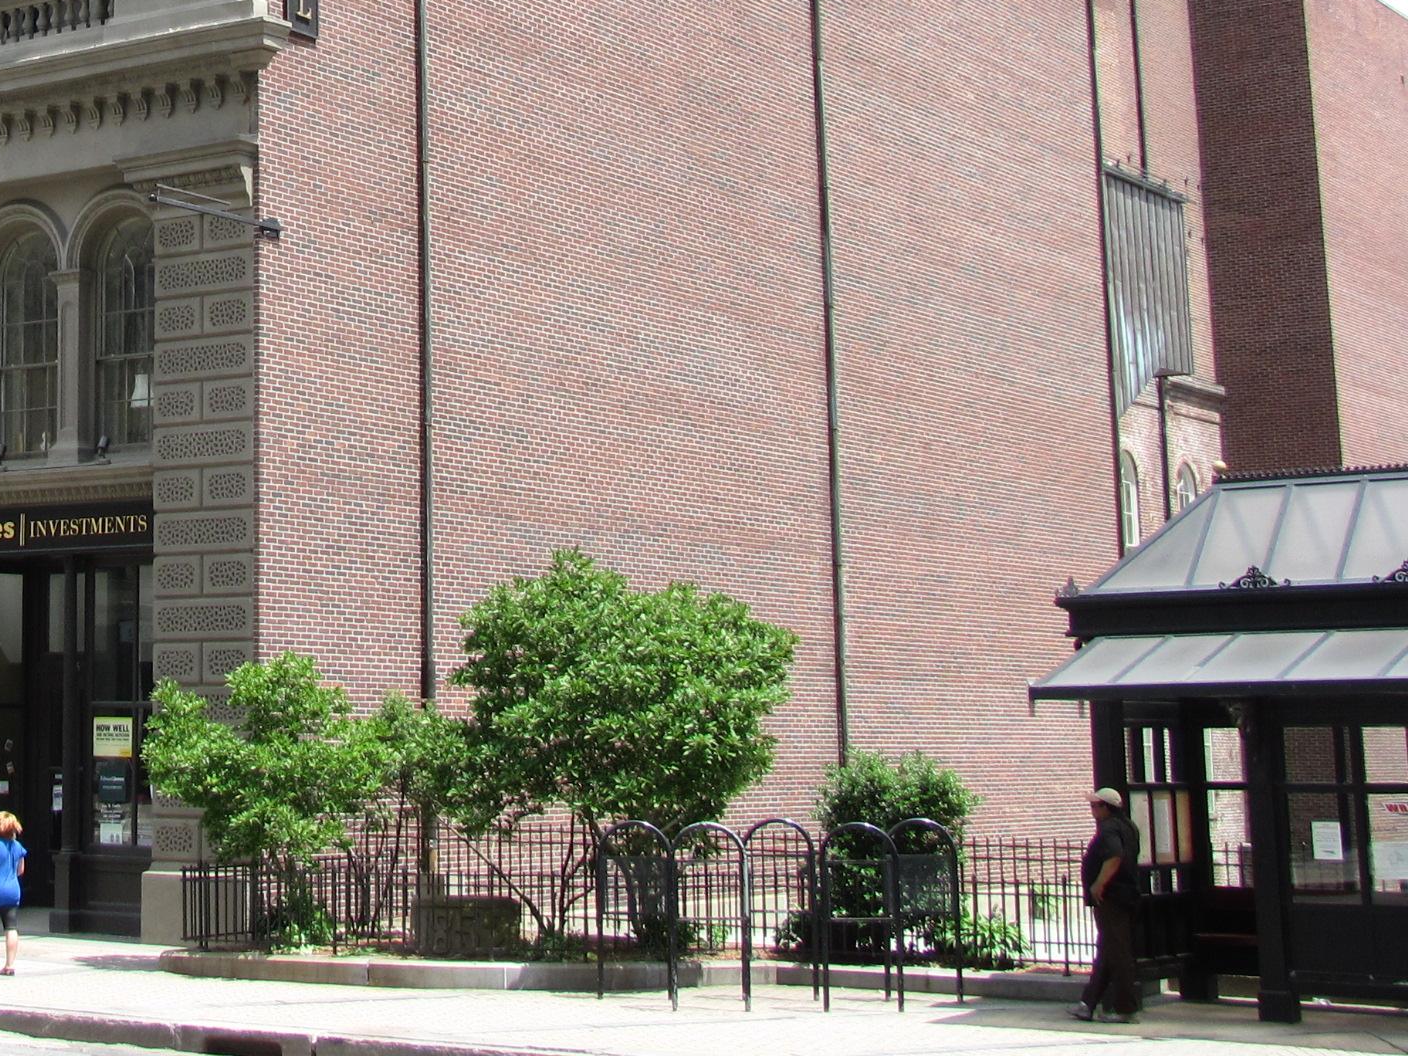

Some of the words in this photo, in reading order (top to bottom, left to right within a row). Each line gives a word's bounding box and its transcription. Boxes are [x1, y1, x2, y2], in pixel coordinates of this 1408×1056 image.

[29, 514, 148, 538] INVESTMENTS
[96, 724, 110, 732] HOW
[112, 724, 129, 732] WELL
